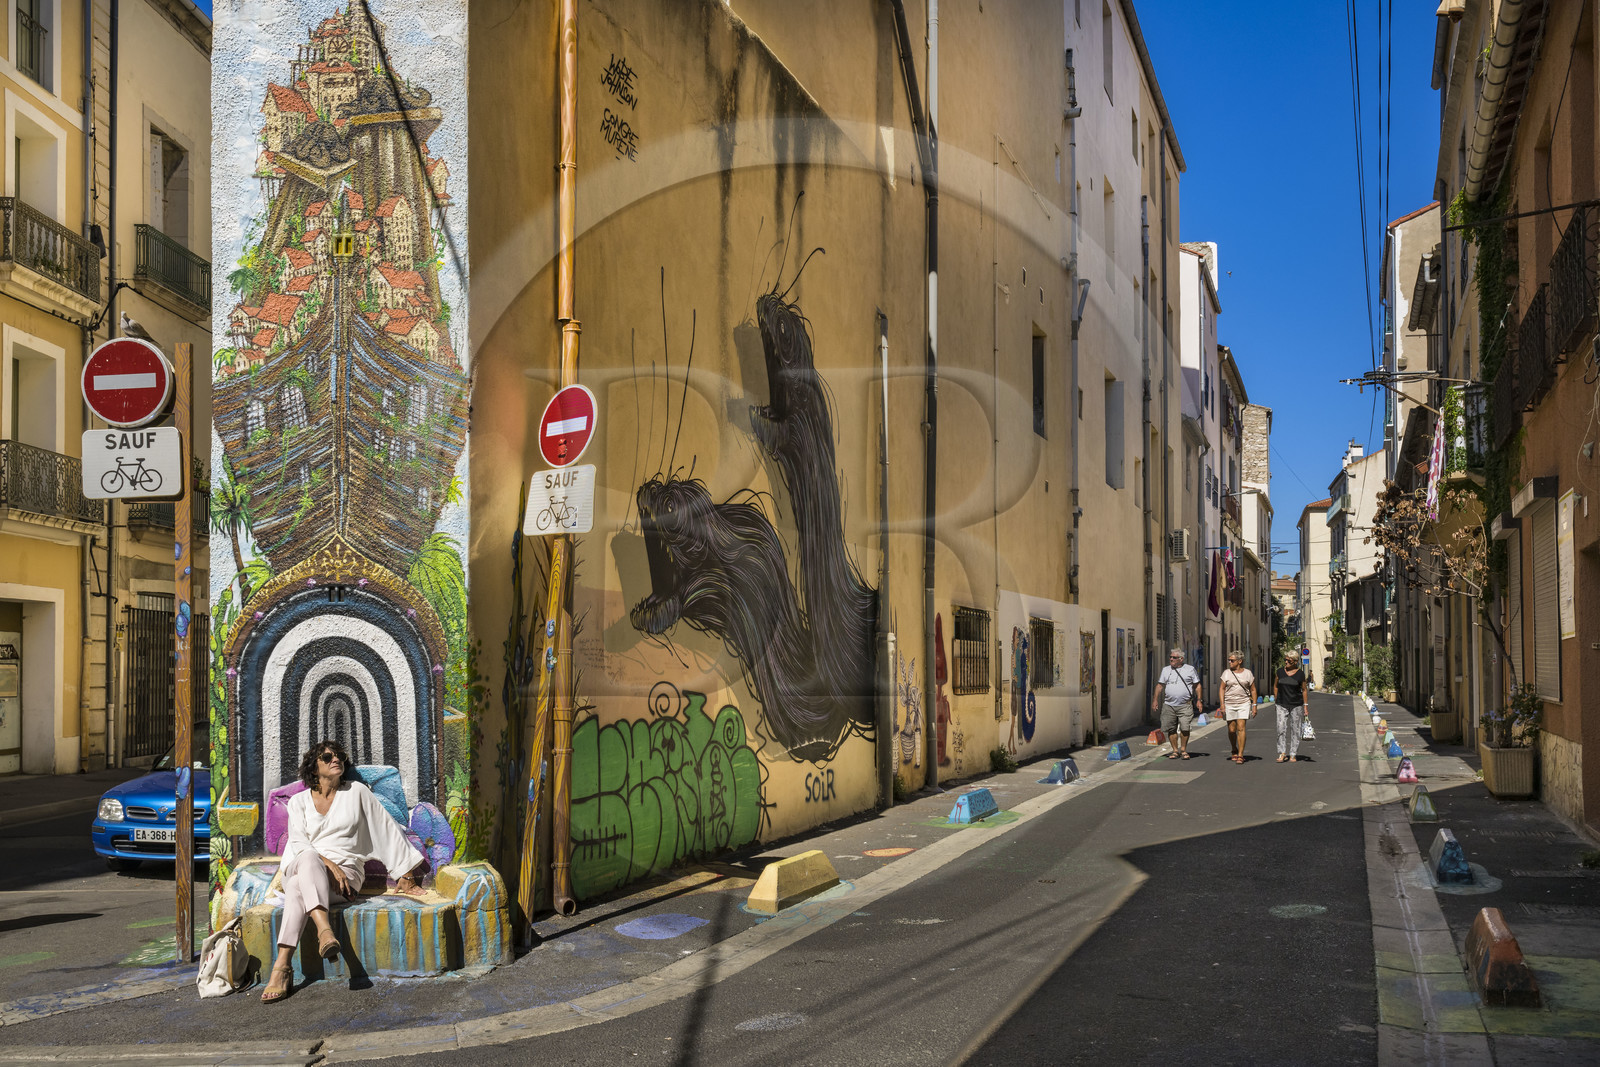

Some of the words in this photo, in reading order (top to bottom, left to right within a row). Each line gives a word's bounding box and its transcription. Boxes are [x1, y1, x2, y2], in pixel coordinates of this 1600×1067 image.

[604, 107, 639, 148] CONGRE
[105, 432, 156, 450] SAUF
[545, 470, 579, 489] SAUF
